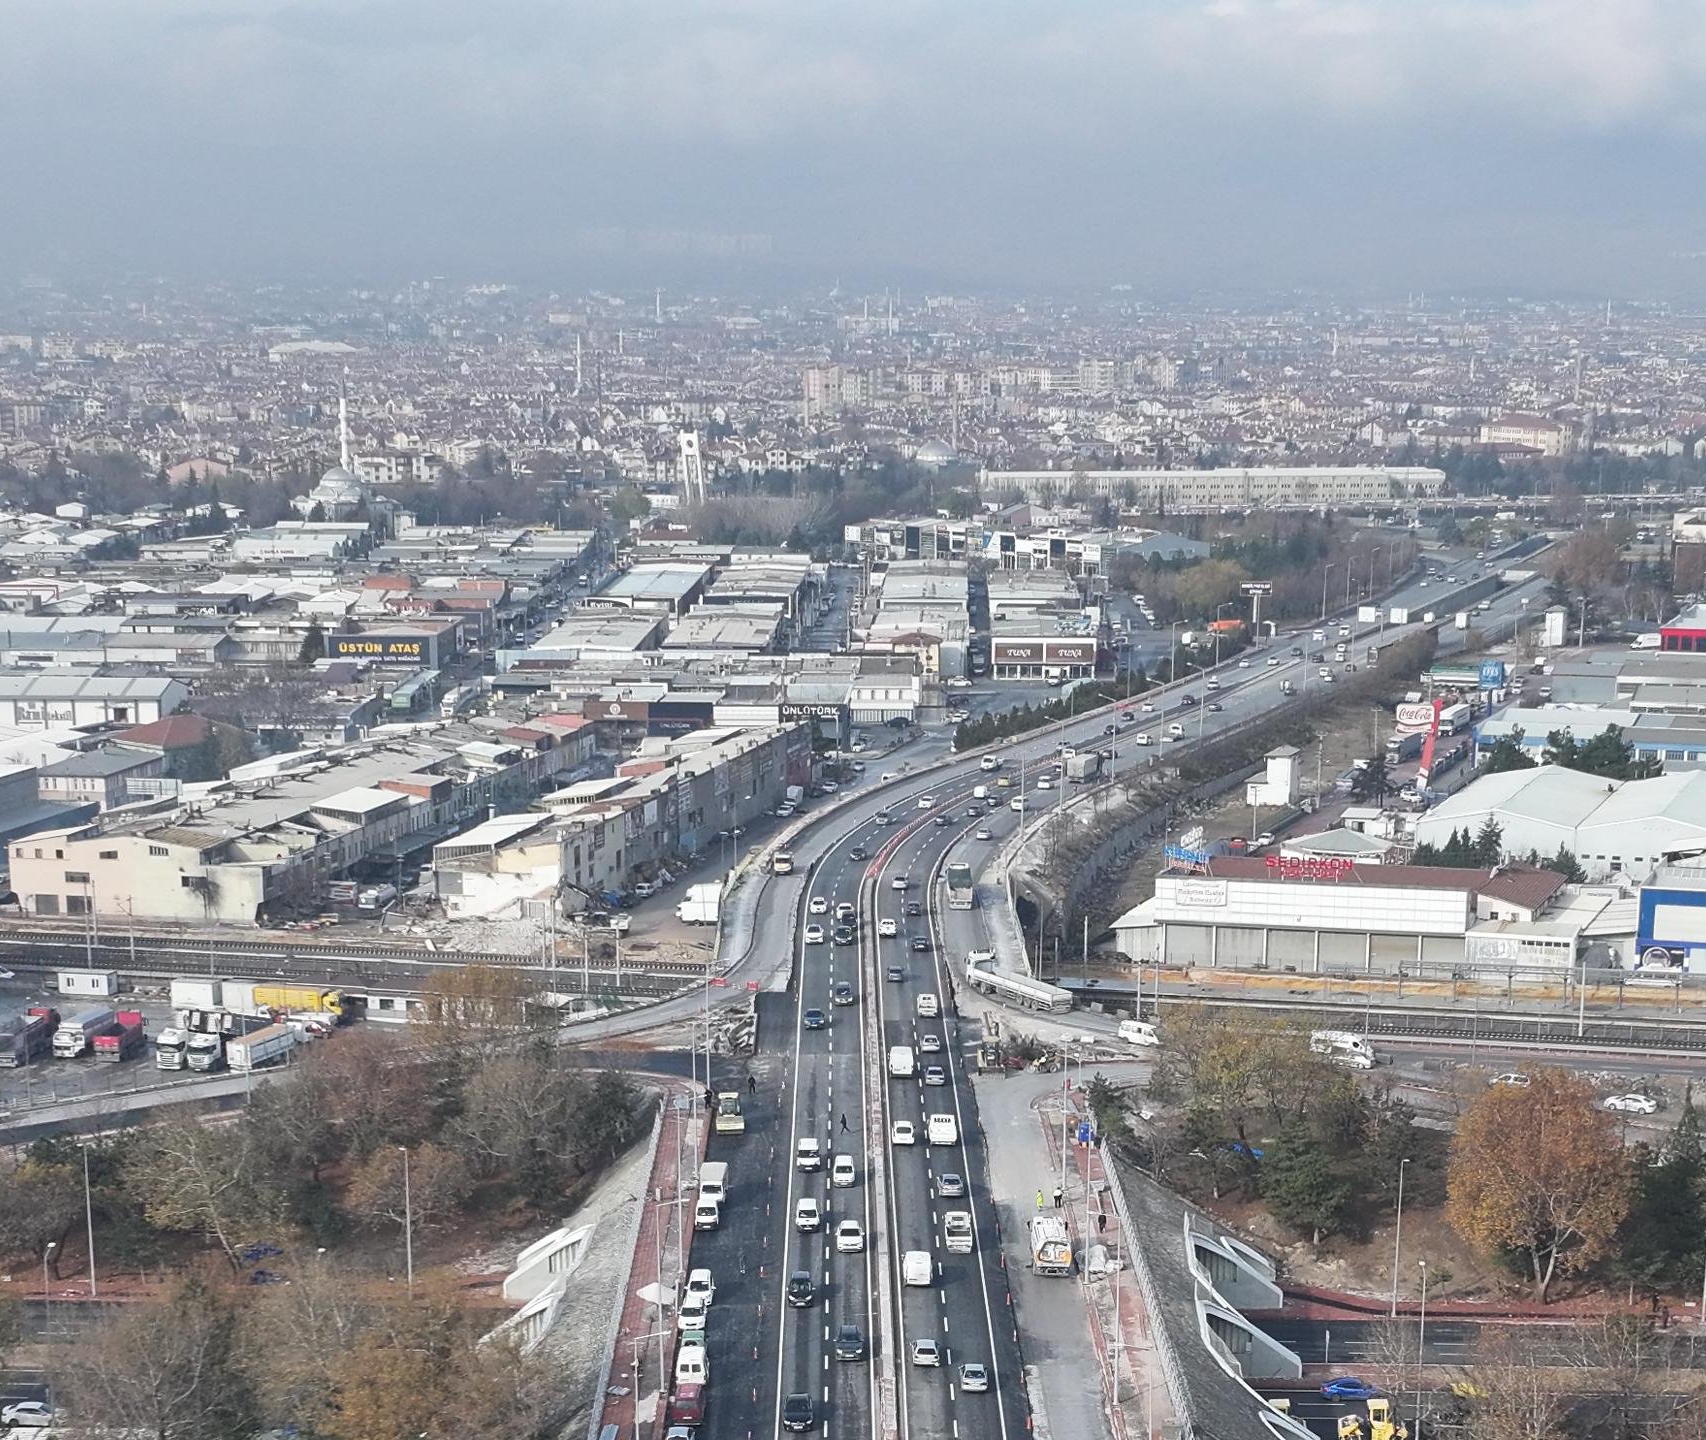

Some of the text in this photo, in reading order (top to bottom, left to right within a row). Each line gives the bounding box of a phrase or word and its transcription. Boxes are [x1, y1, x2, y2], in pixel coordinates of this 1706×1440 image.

[339, 642, 420, 655] ÜSTÜN ATAŞ
[1007, 648, 1031, 657] TUNA
[1058, 649, 1082, 658] TUNA
